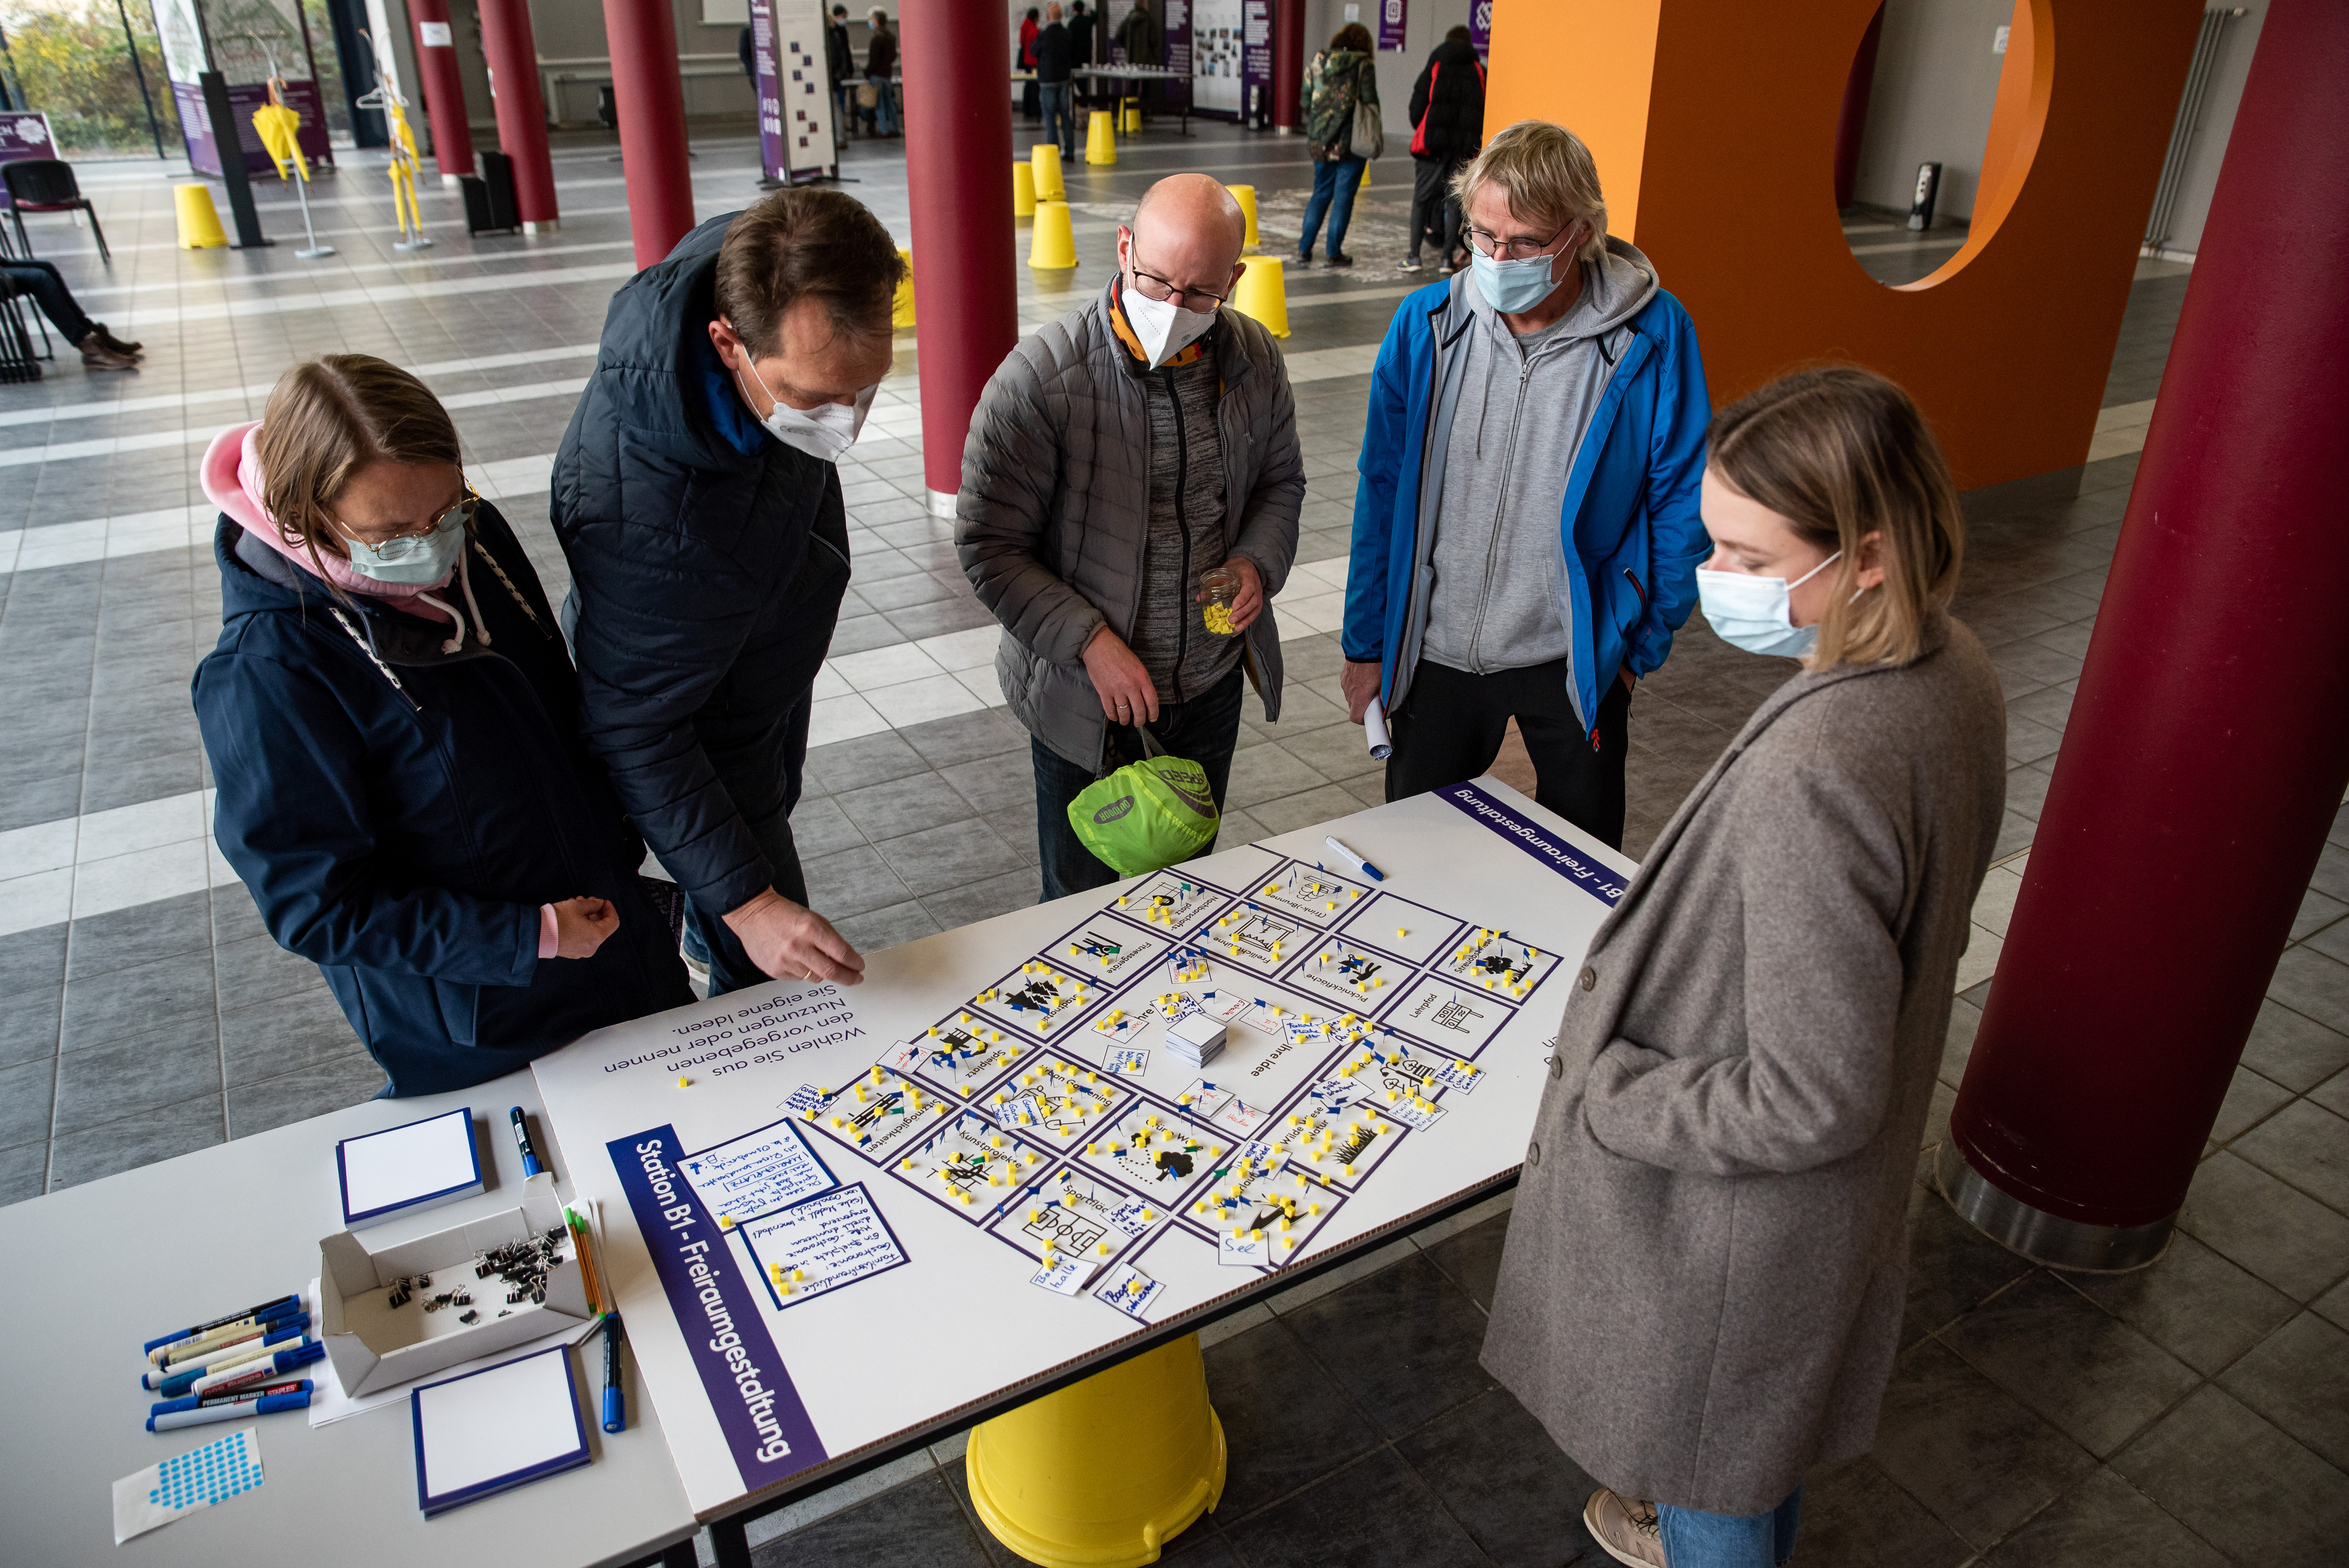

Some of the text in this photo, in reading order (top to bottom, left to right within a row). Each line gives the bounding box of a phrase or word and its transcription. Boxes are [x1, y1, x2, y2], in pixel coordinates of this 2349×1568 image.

[1454, 789, 1589, 879] Freiraumgestaltung
[1171, 896, 1219, 930] Nachbarschafts-
[1172, 902, 1192, 915] platz
[1107, 942, 1151, 973] Fitnessgeräte
[1304, 974, 1368, 1002] Picknickfläche
[672, 984, 837, 1035] Sie eigene Ideen.
[1135, 1009, 1154, 1022] hre
[1222, 1000, 1245, 1016] Eishalle
[1409, 993, 1437, 1018] Lehrpfad
[604, 997, 847, 1073] Nutzungen oder nennen
[667, 1011, 854, 1073] den vorgegebenen
[713, 1026, 866, 1076] Wählen Sie aus
[966, 1050, 1006, 1078] Spielplatz
[1251, 1043, 1293, 1076] Ihre Idee
[866, 1099, 941, 1152] Sitzmöglichkeiten
[1280, 1124, 1304, 1144] Wilde
[959, 1130, 1021, 1170] Kunstprojekte
[636, 1139, 677, 1206] Station
[726, 1155, 802, 1187] MARIENPLATZ
[842, 1187, 857, 1195] von
[663, 1203, 697, 1231] B1
[808, 1205, 837, 1219] Modell
[819, 1208, 868, 1229] angrenzend
[842, 1216, 870, 1230] direkt
[814, 1239, 862, 1260] Spielplatz
[864, 1232, 879, 1240] Ein
[679, 1239, 792, 1463] Freiraumgestaltung
[202, 1390, 265, 1407] PERMANENT MARKER
[267, 1385, 295, 1397] STAPLES
